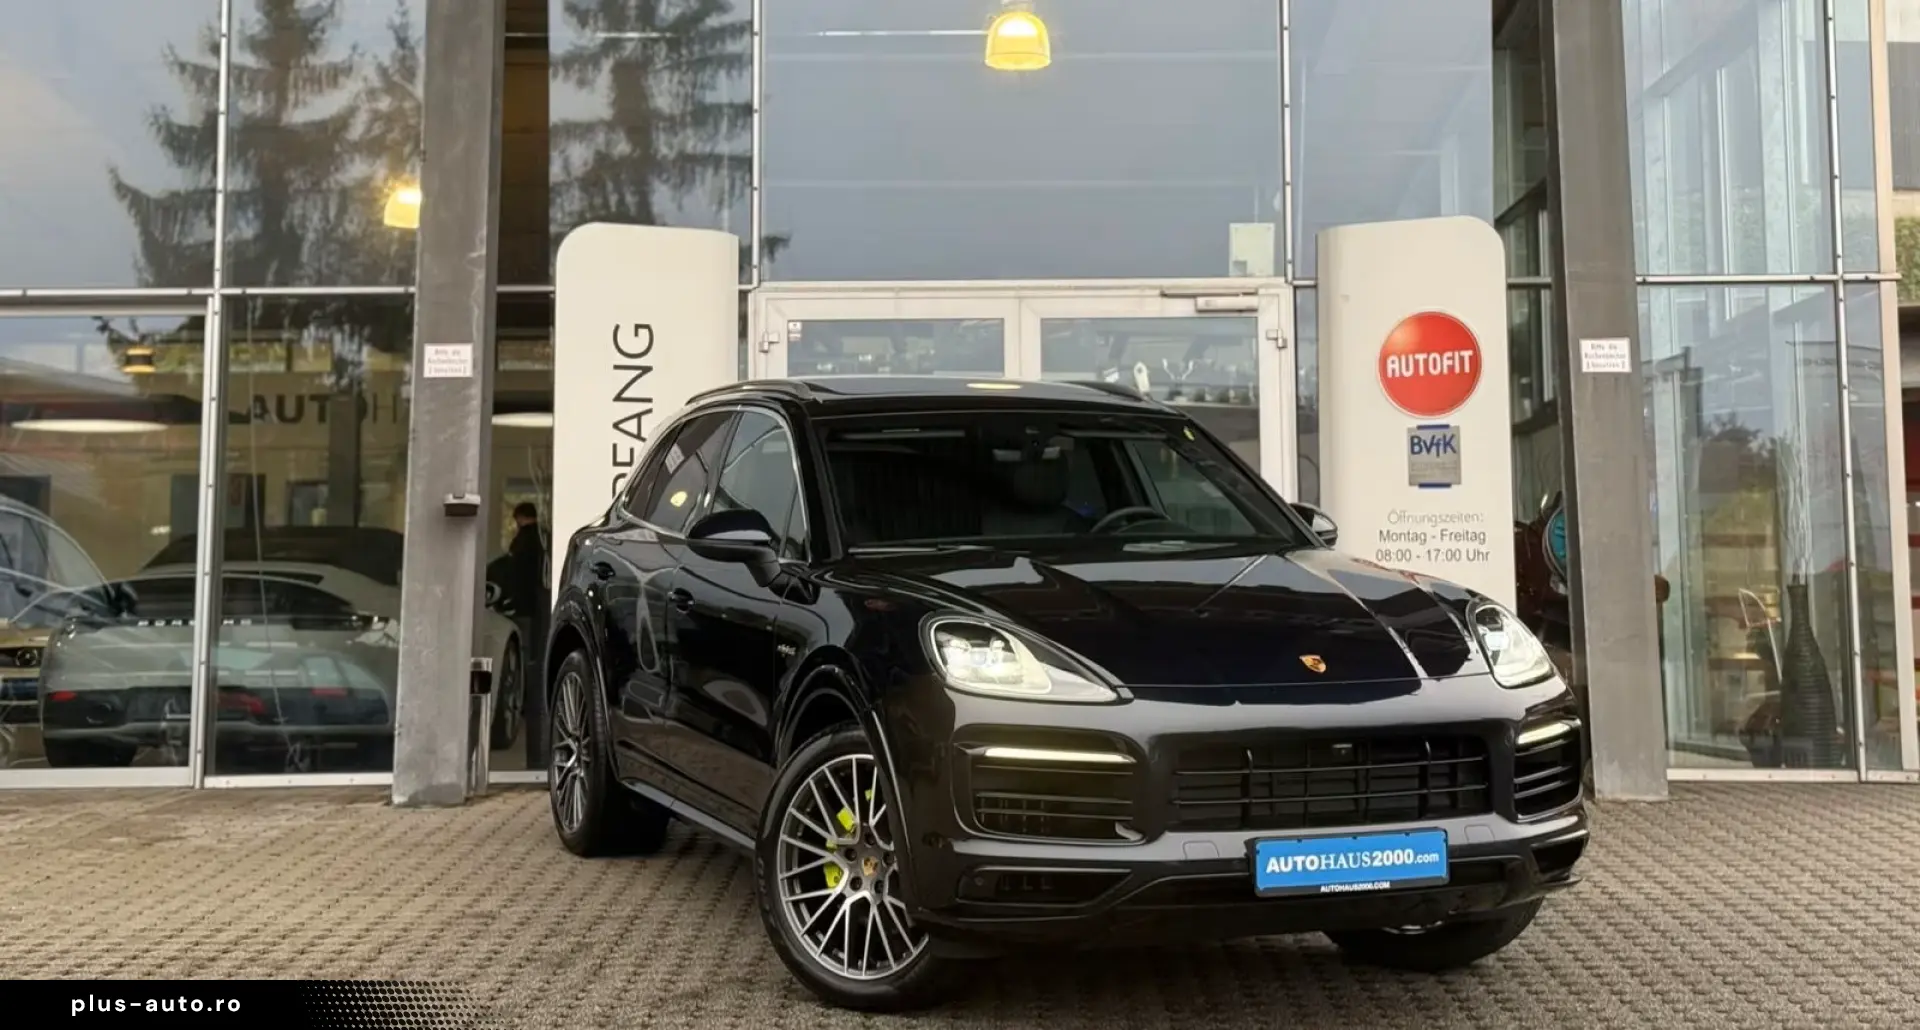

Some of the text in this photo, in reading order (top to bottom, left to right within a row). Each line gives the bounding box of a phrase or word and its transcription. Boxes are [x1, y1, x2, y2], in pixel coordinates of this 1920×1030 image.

[1386, 350, 1473, 378] AUTOFIT
[1387, 508, 1485, 528] Öffnungszeiten:
[1379, 529, 1428, 546] Montag
[1440, 528, 1487, 546] Freitag
[1375, 548, 1413, 562] 08:00
[1426, 548, 1462, 562] 17:00
[1466, 547, 1491, 562] Uhr
[1265, 848, 1441, 874] AUTOHAUS2000.com
[1320, 881, 1392, 894] AUTOHAUS2000.COM
